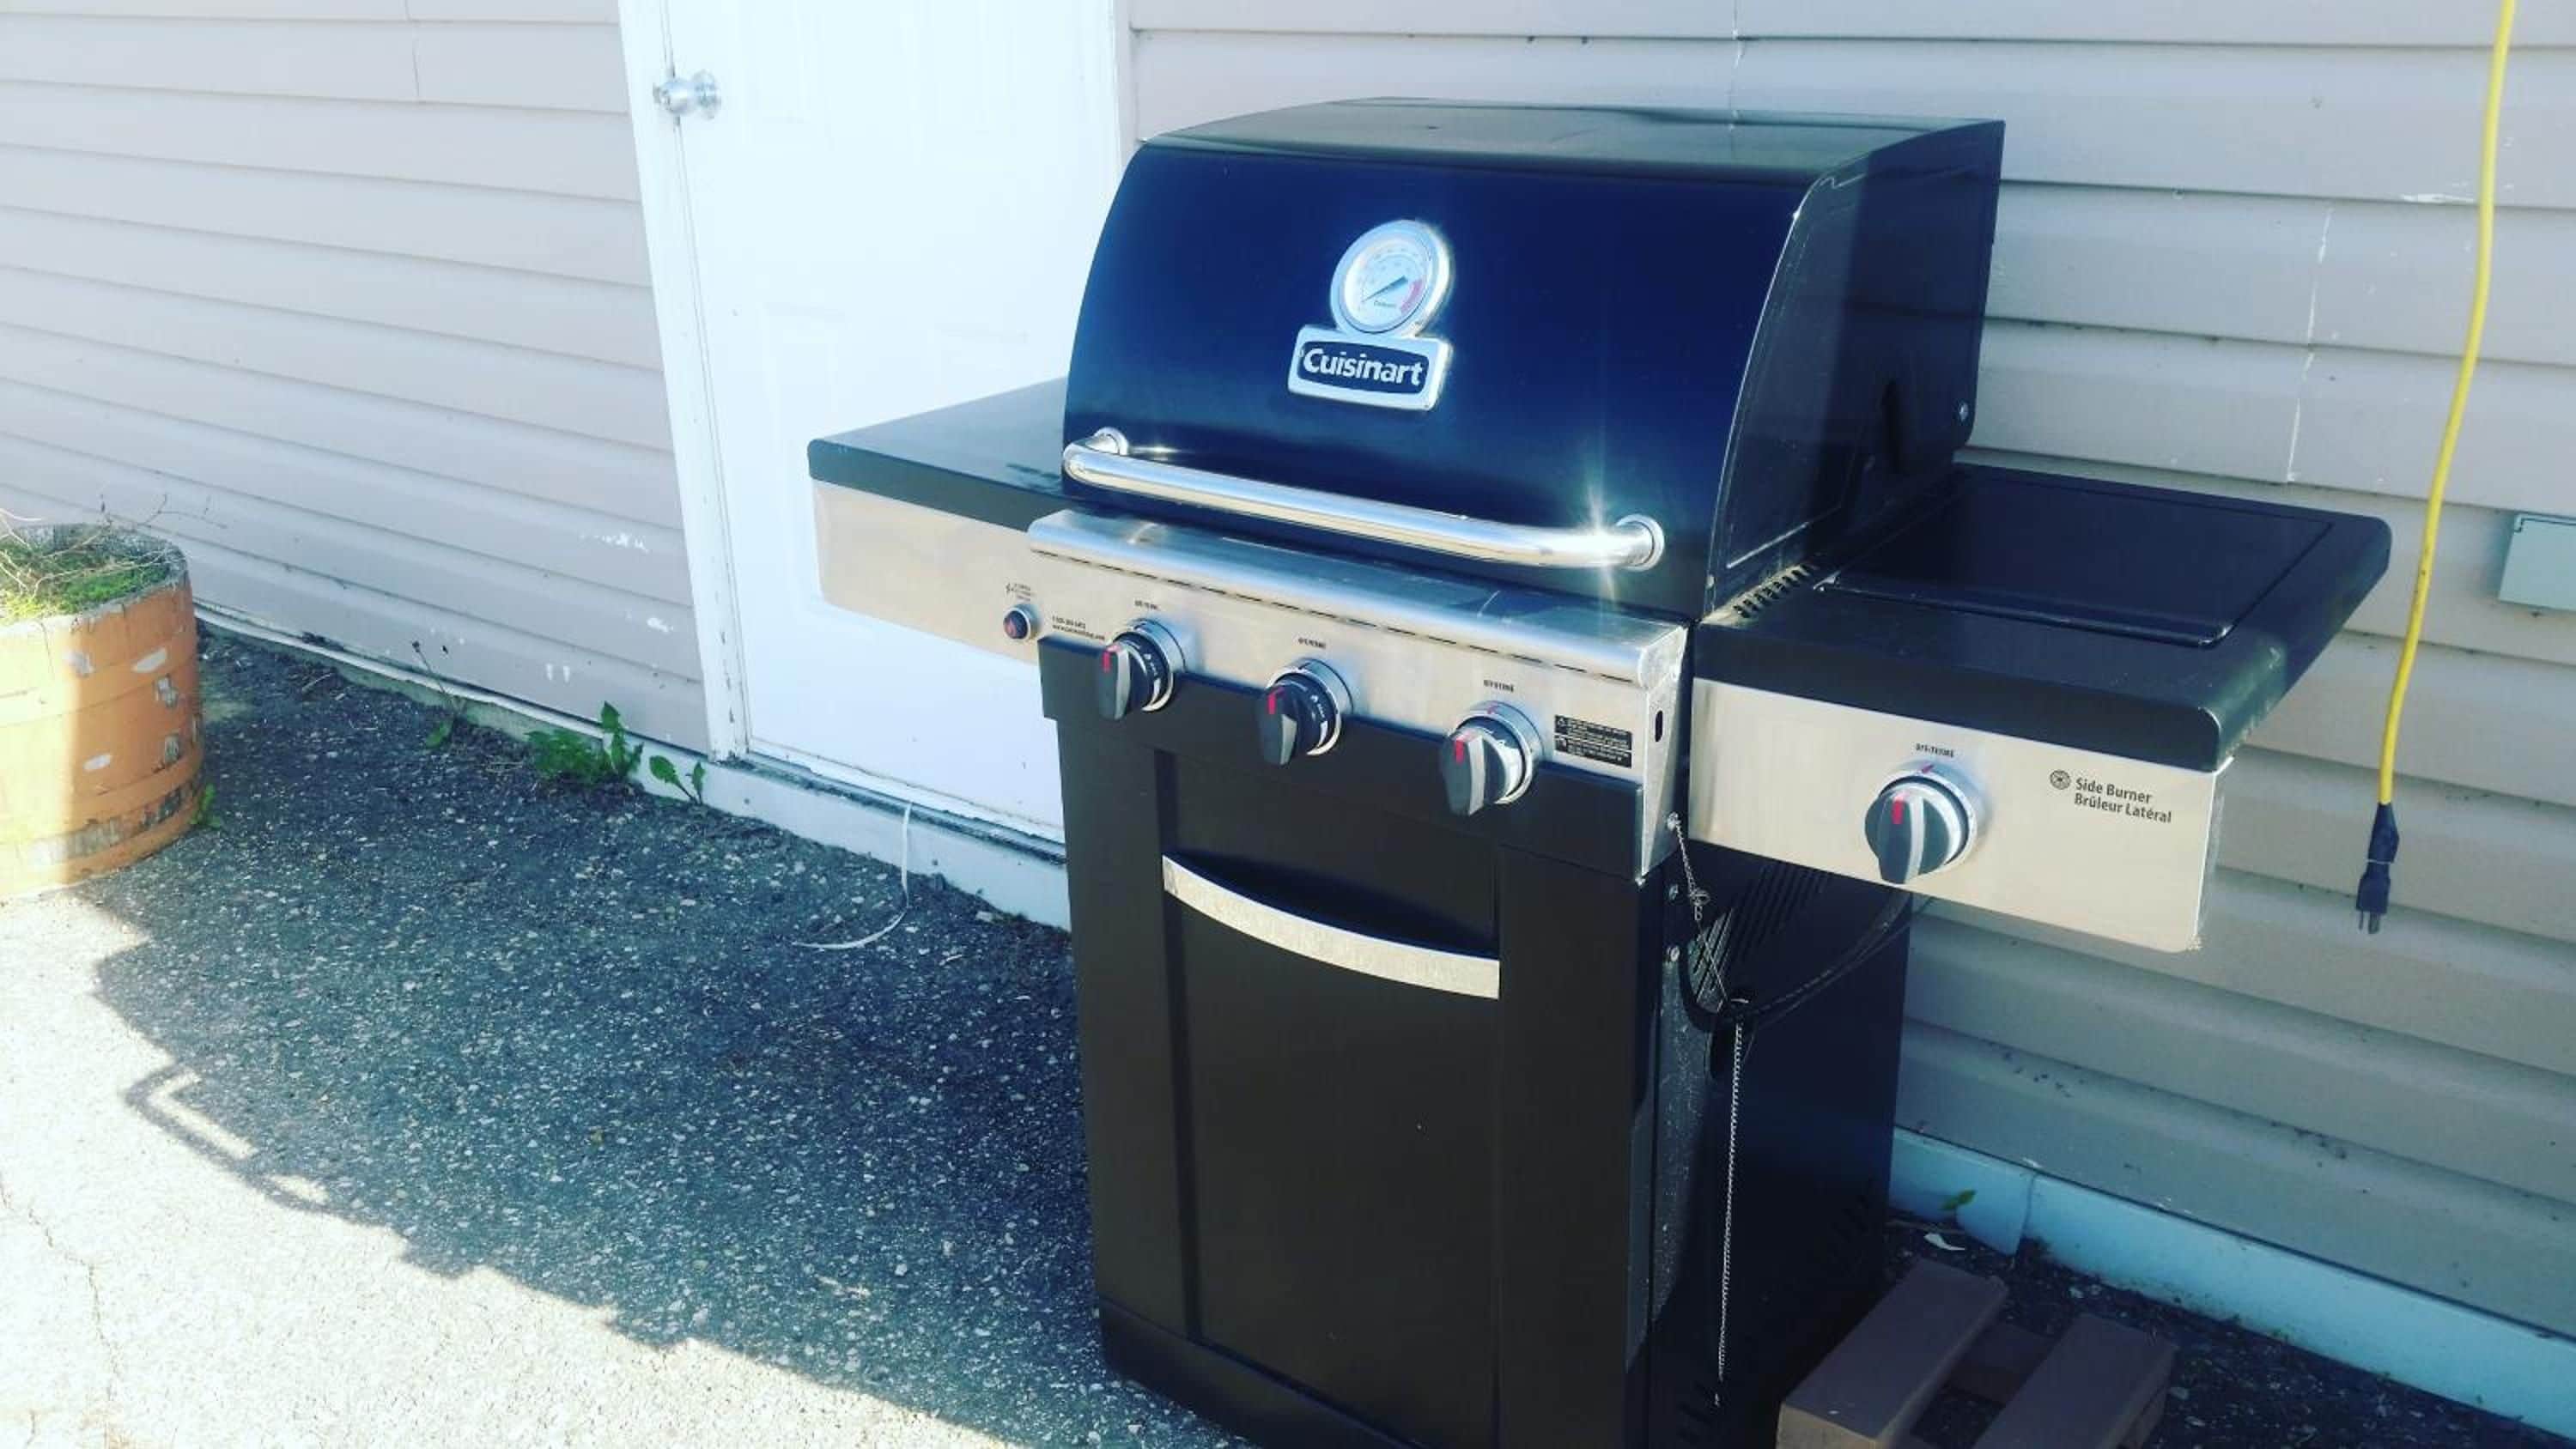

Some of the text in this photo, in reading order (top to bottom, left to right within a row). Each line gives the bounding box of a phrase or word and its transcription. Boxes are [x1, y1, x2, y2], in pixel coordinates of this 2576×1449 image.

[1303, 349, 1424, 385] Cuisinart
[2075, 777, 2153, 803] Side Burner
[2125, 803, 2172, 823] Latéral
